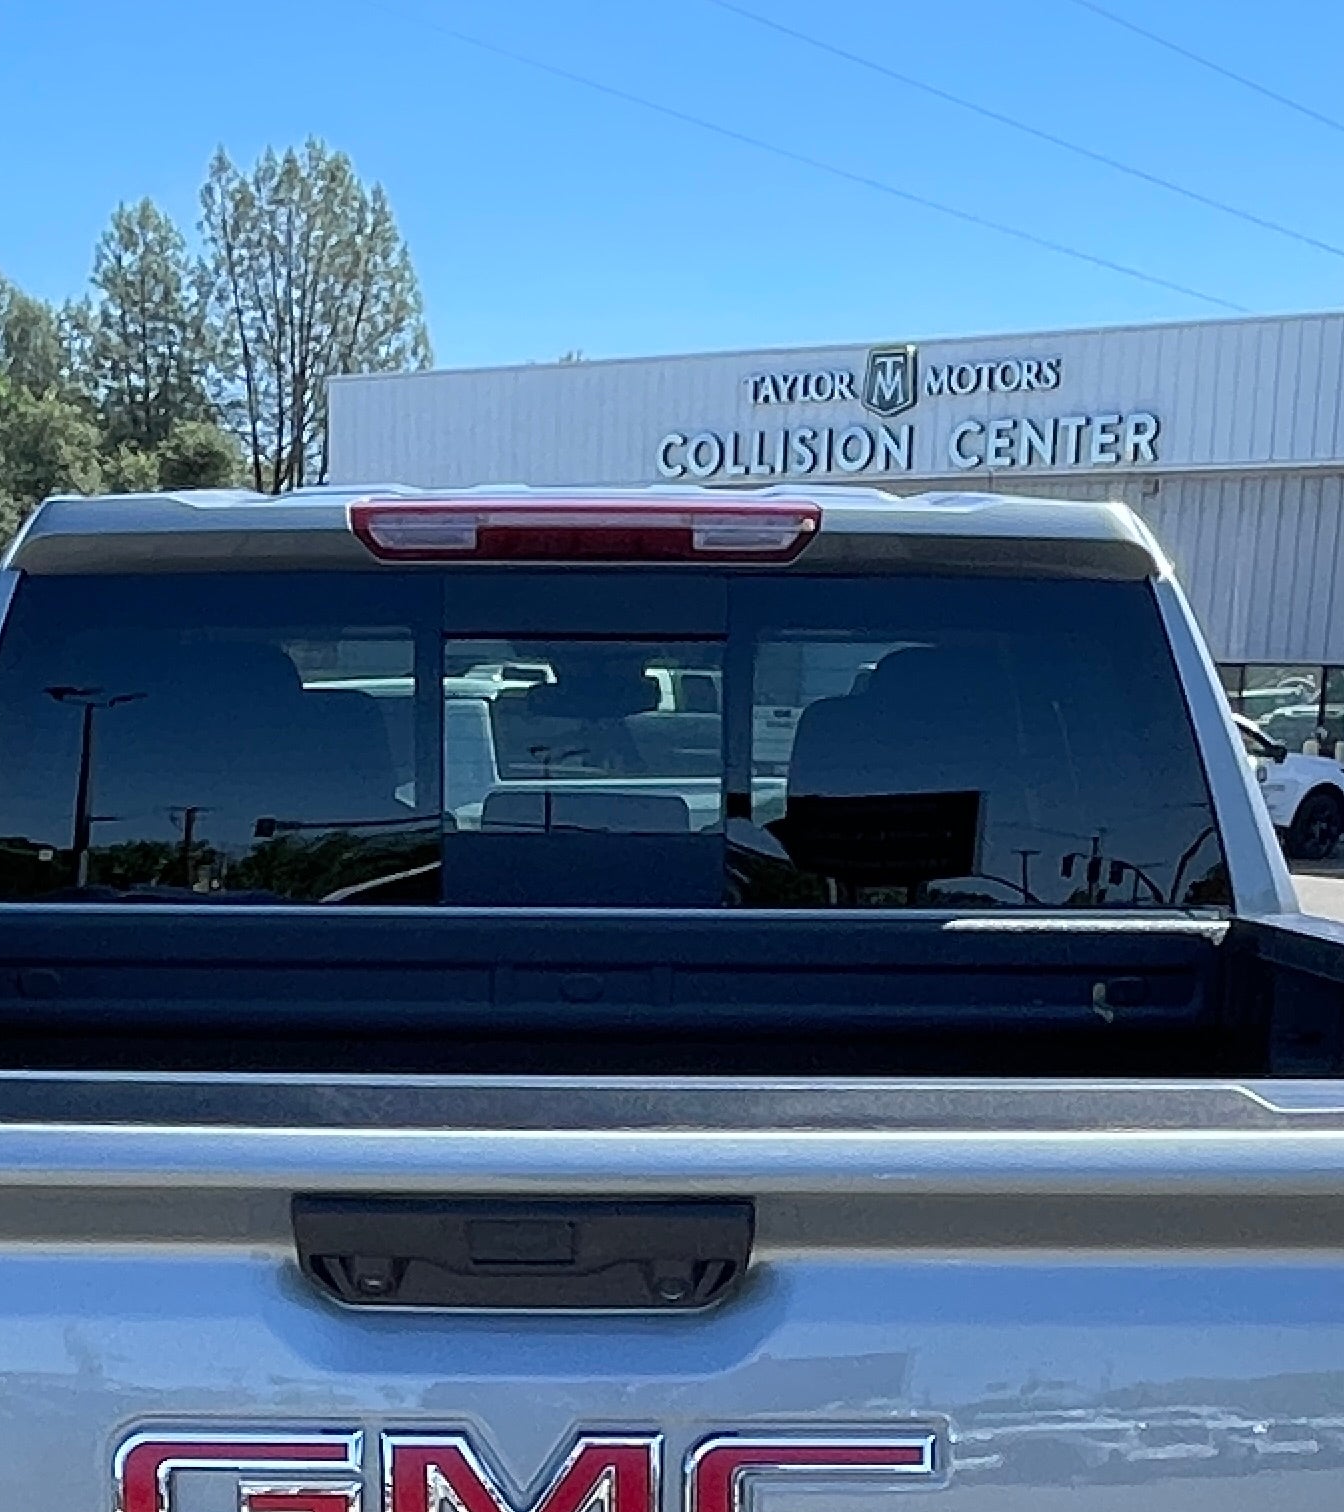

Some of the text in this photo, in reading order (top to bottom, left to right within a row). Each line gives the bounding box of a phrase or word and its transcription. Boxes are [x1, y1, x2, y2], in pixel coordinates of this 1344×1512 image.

[744, 370, 857, 404] TAYLOR
[924, 357, 1062, 397] MOTORS
[656, 413, 1160, 479] COLLISION CENTER
